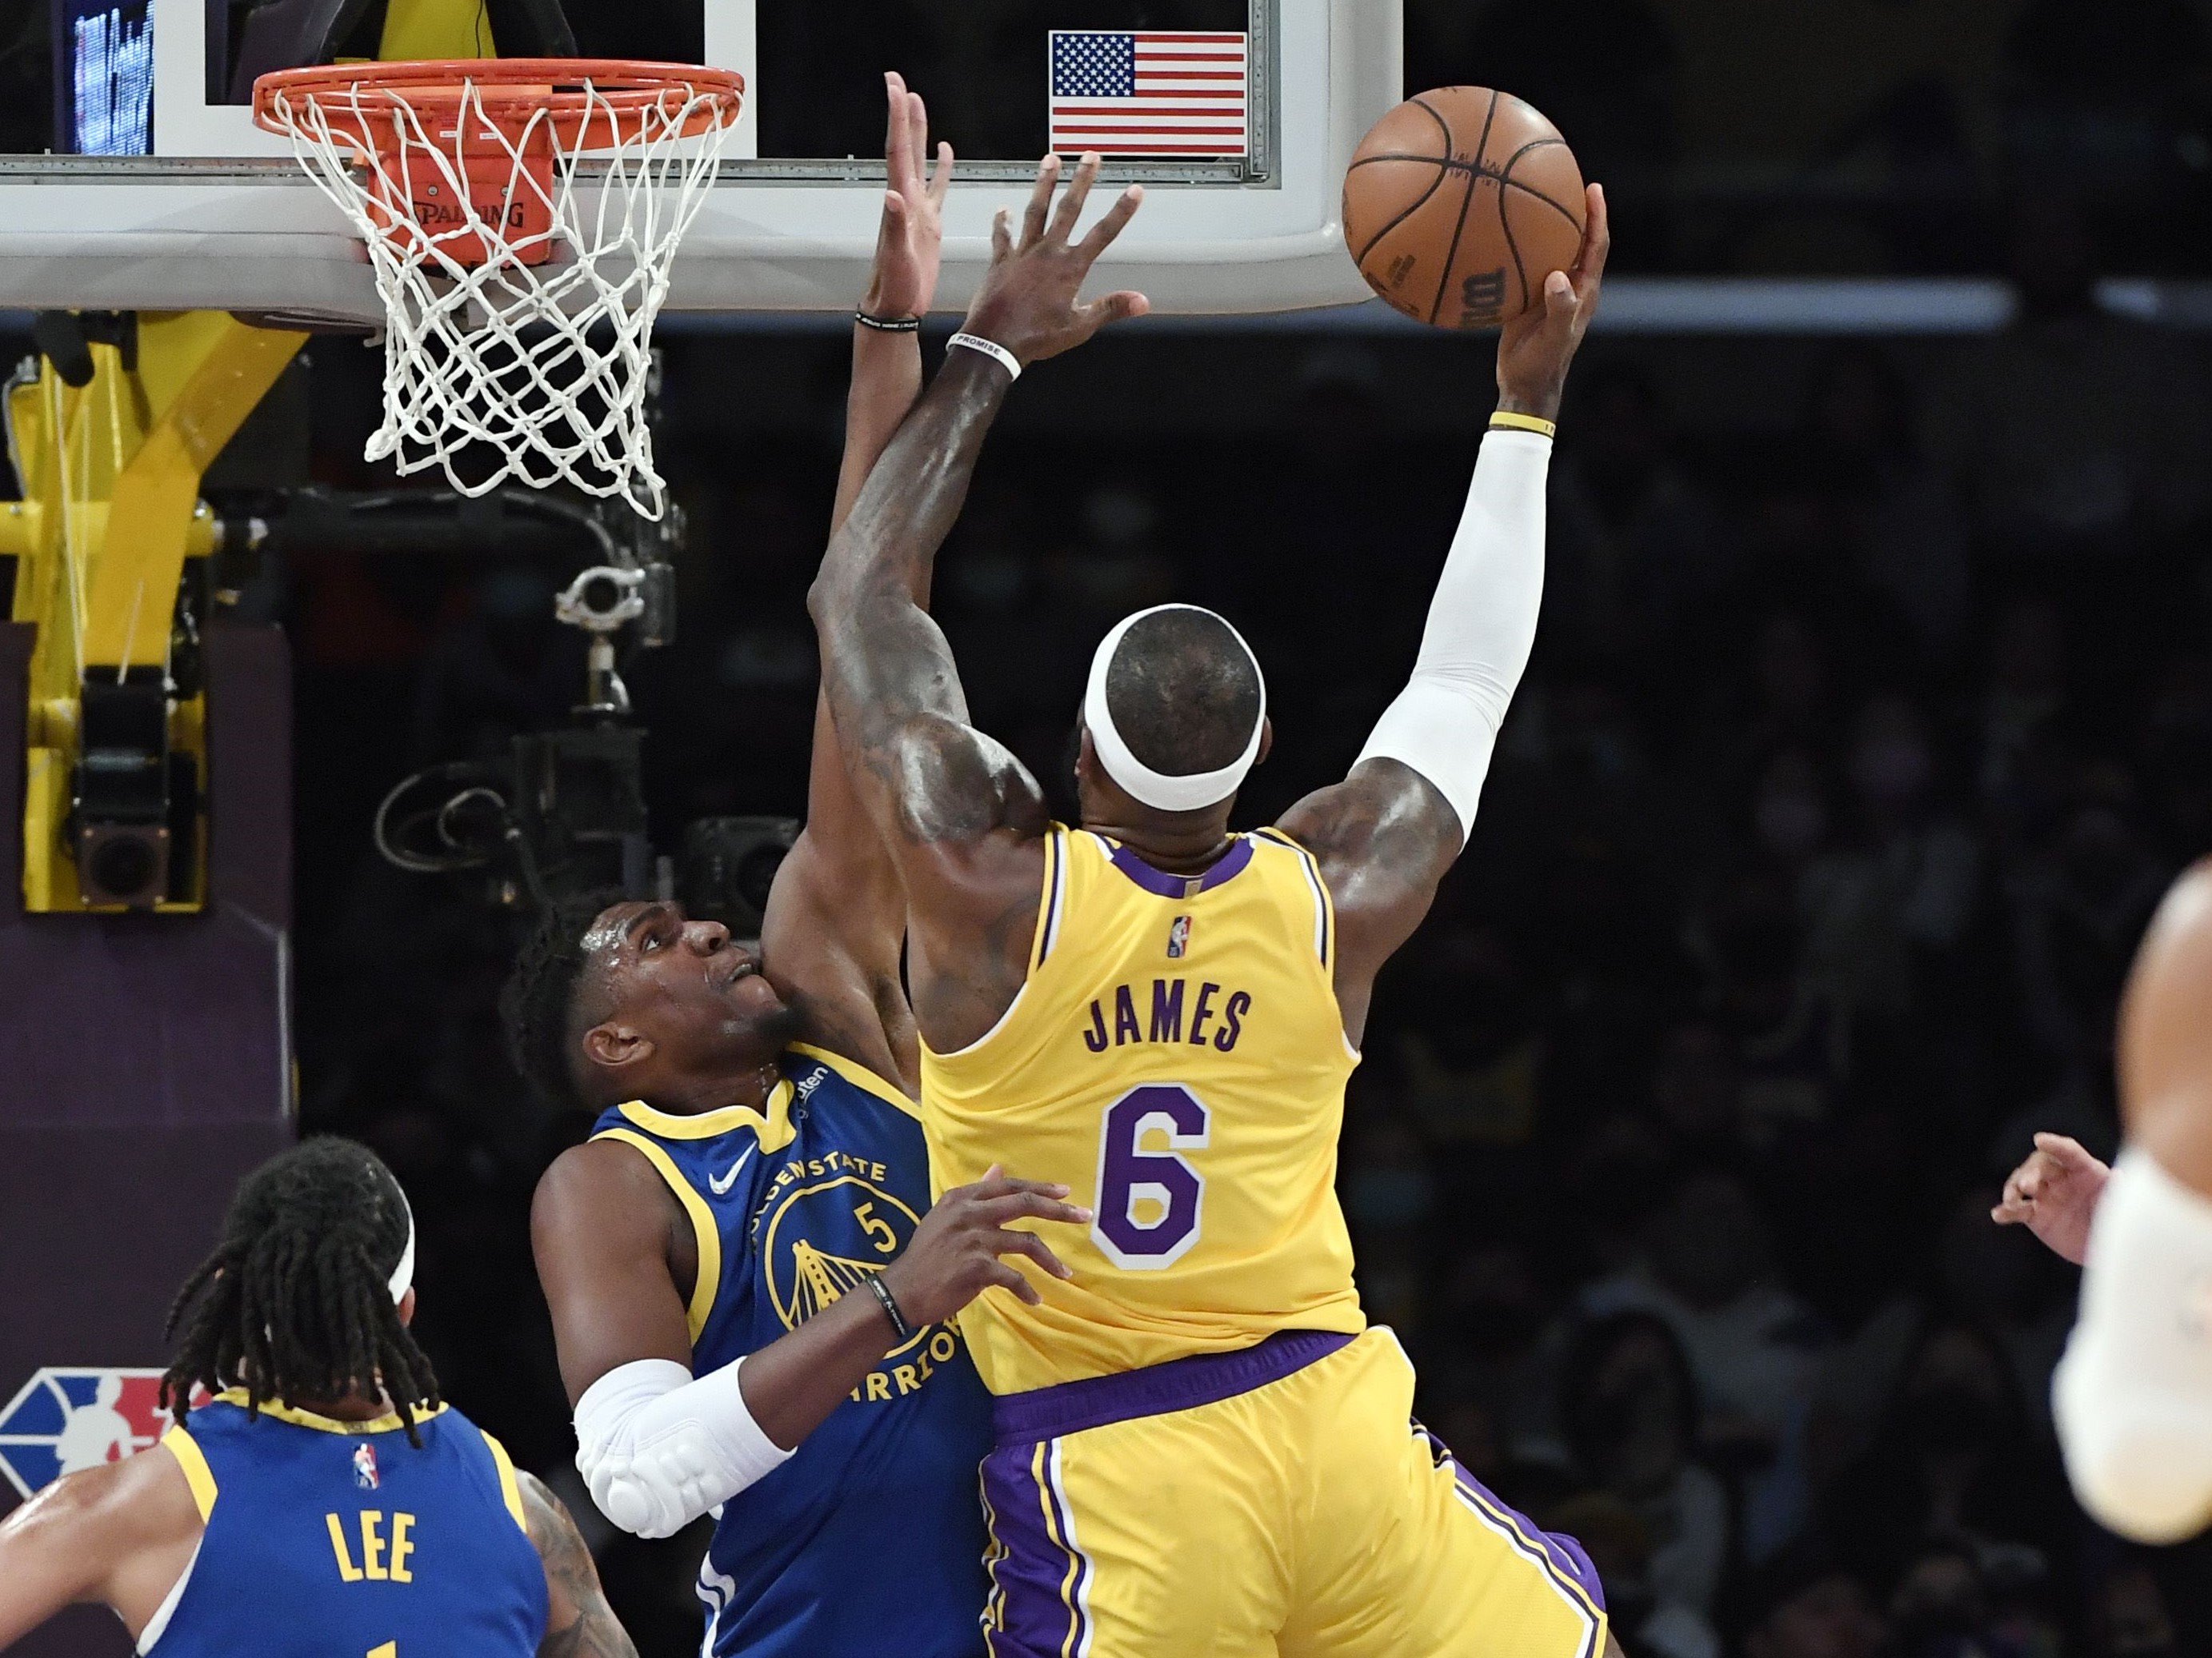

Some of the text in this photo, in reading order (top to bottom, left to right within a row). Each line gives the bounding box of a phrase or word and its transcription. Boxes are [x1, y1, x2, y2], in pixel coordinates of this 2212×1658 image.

[957, 335, 1002, 355] PROMISE
[1083, 978, 1251, 1053] JAMES
[797, 1065, 829, 1101] uten
[807, 1150, 887, 1182] STATE
[1090, 1081, 1211, 1271] 6
[853, 1201, 898, 1253] 5
[325, 1509, 416, 1584] LEE
